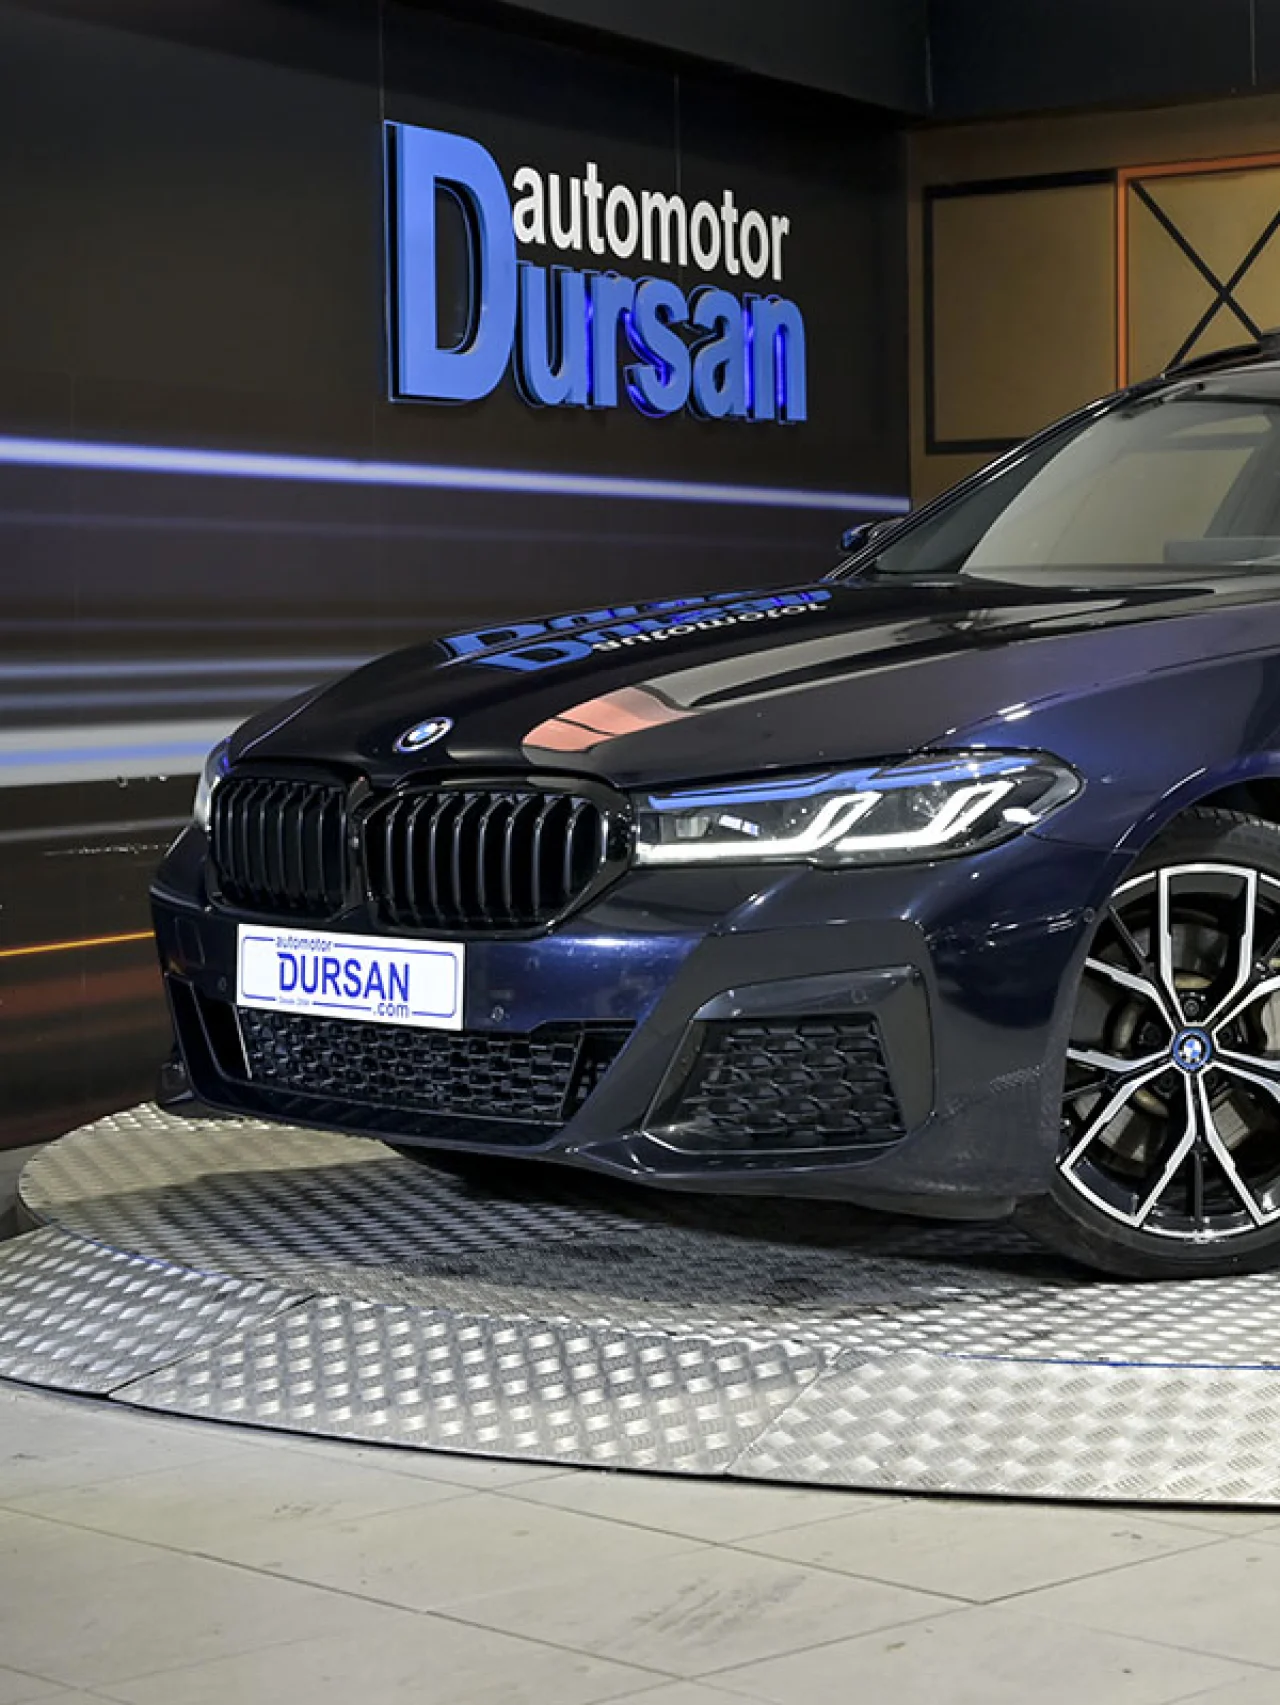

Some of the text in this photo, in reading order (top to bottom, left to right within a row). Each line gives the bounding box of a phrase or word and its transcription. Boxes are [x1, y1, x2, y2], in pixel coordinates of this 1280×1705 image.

[512, 162, 791, 281] automotor
[384, 119, 808, 424] Dursan
[276, 935, 332, 952] automotor
[277, 952, 410, 1001] DURSAN
[372, 1003, 410, 1018] .com
